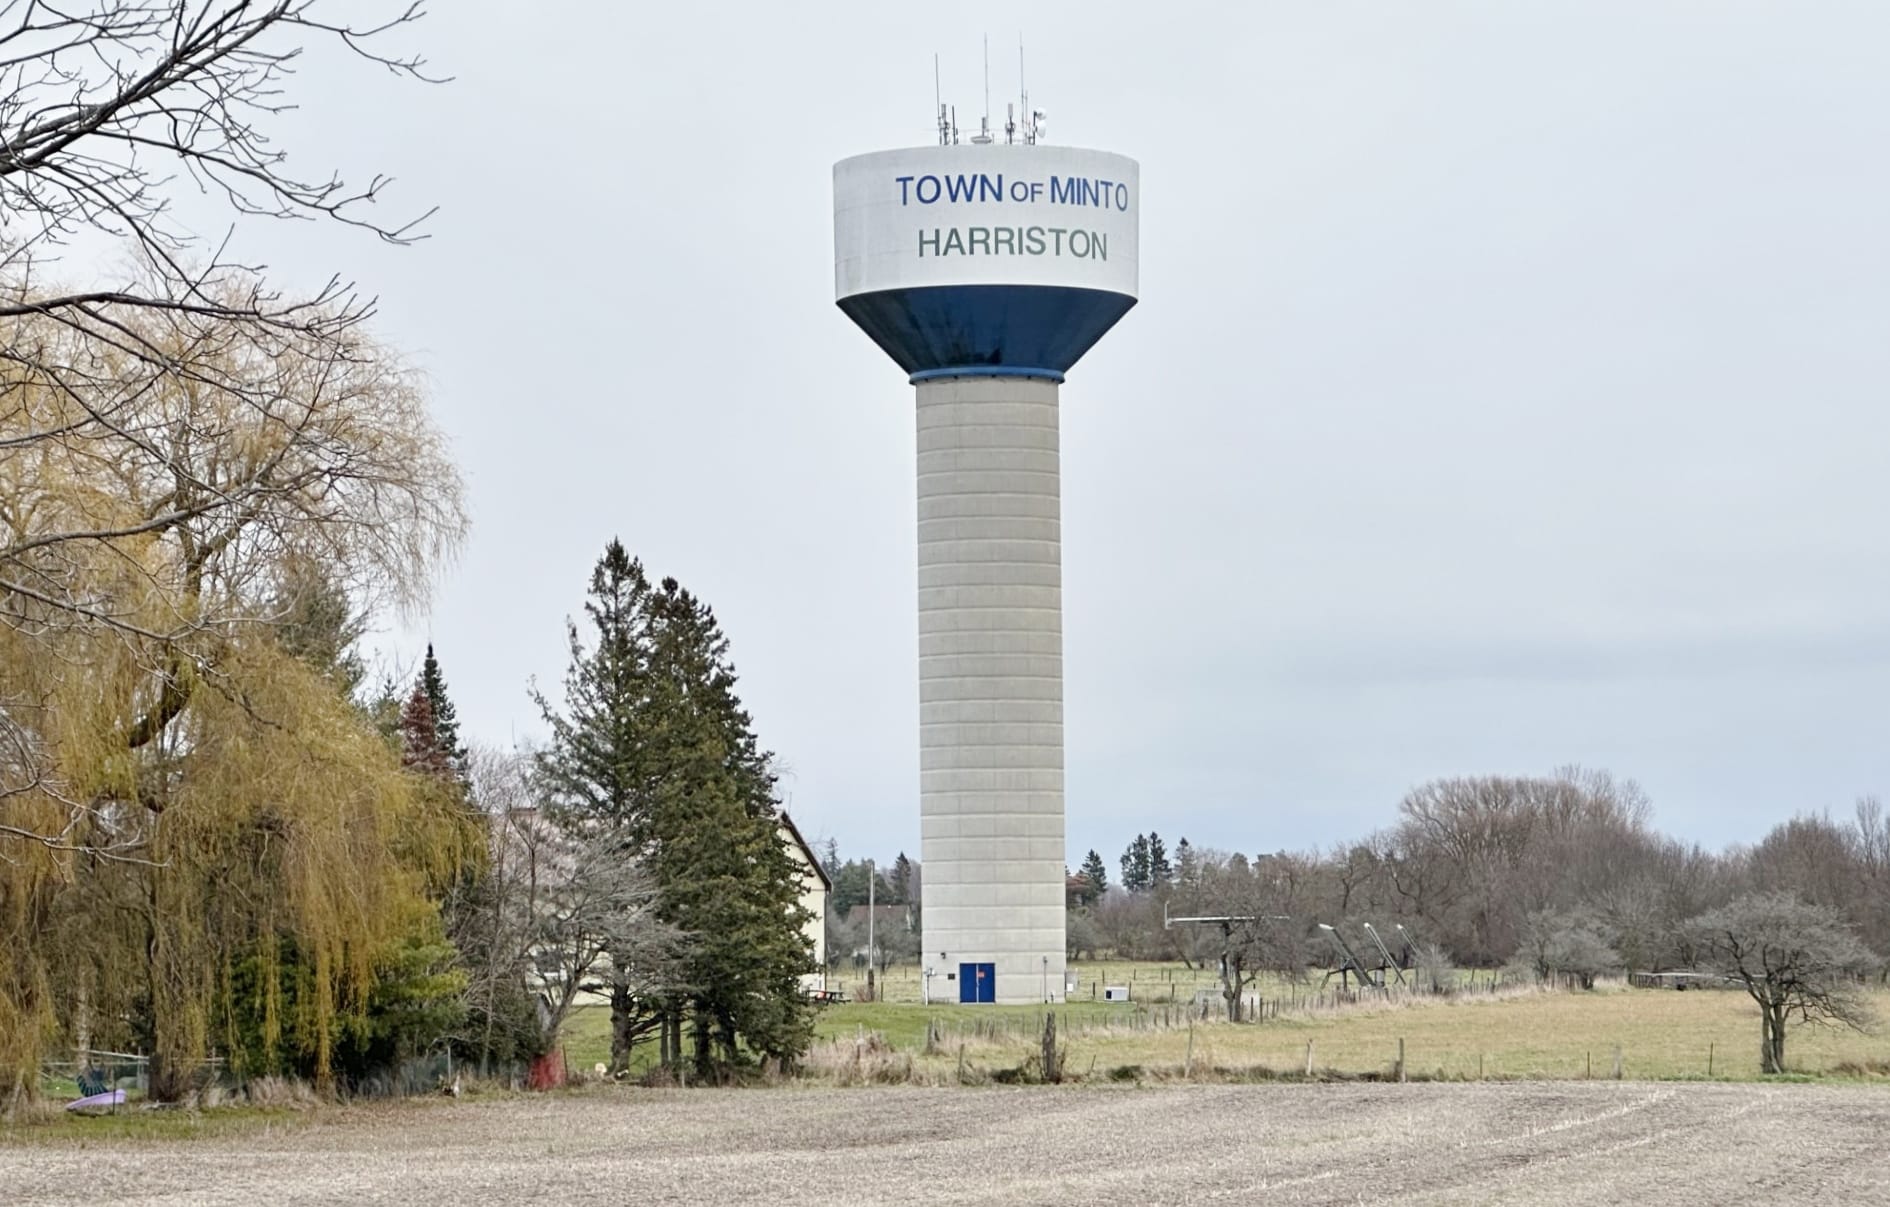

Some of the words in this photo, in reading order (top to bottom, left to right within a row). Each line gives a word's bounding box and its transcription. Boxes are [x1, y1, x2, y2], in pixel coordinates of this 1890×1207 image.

[895, 174, 1003, 206] TOWN
[1010, 181, 1043, 202] OF
[1050, 175, 1128, 211] MINTO
[918, 226, 1107, 261] HARRISTON
